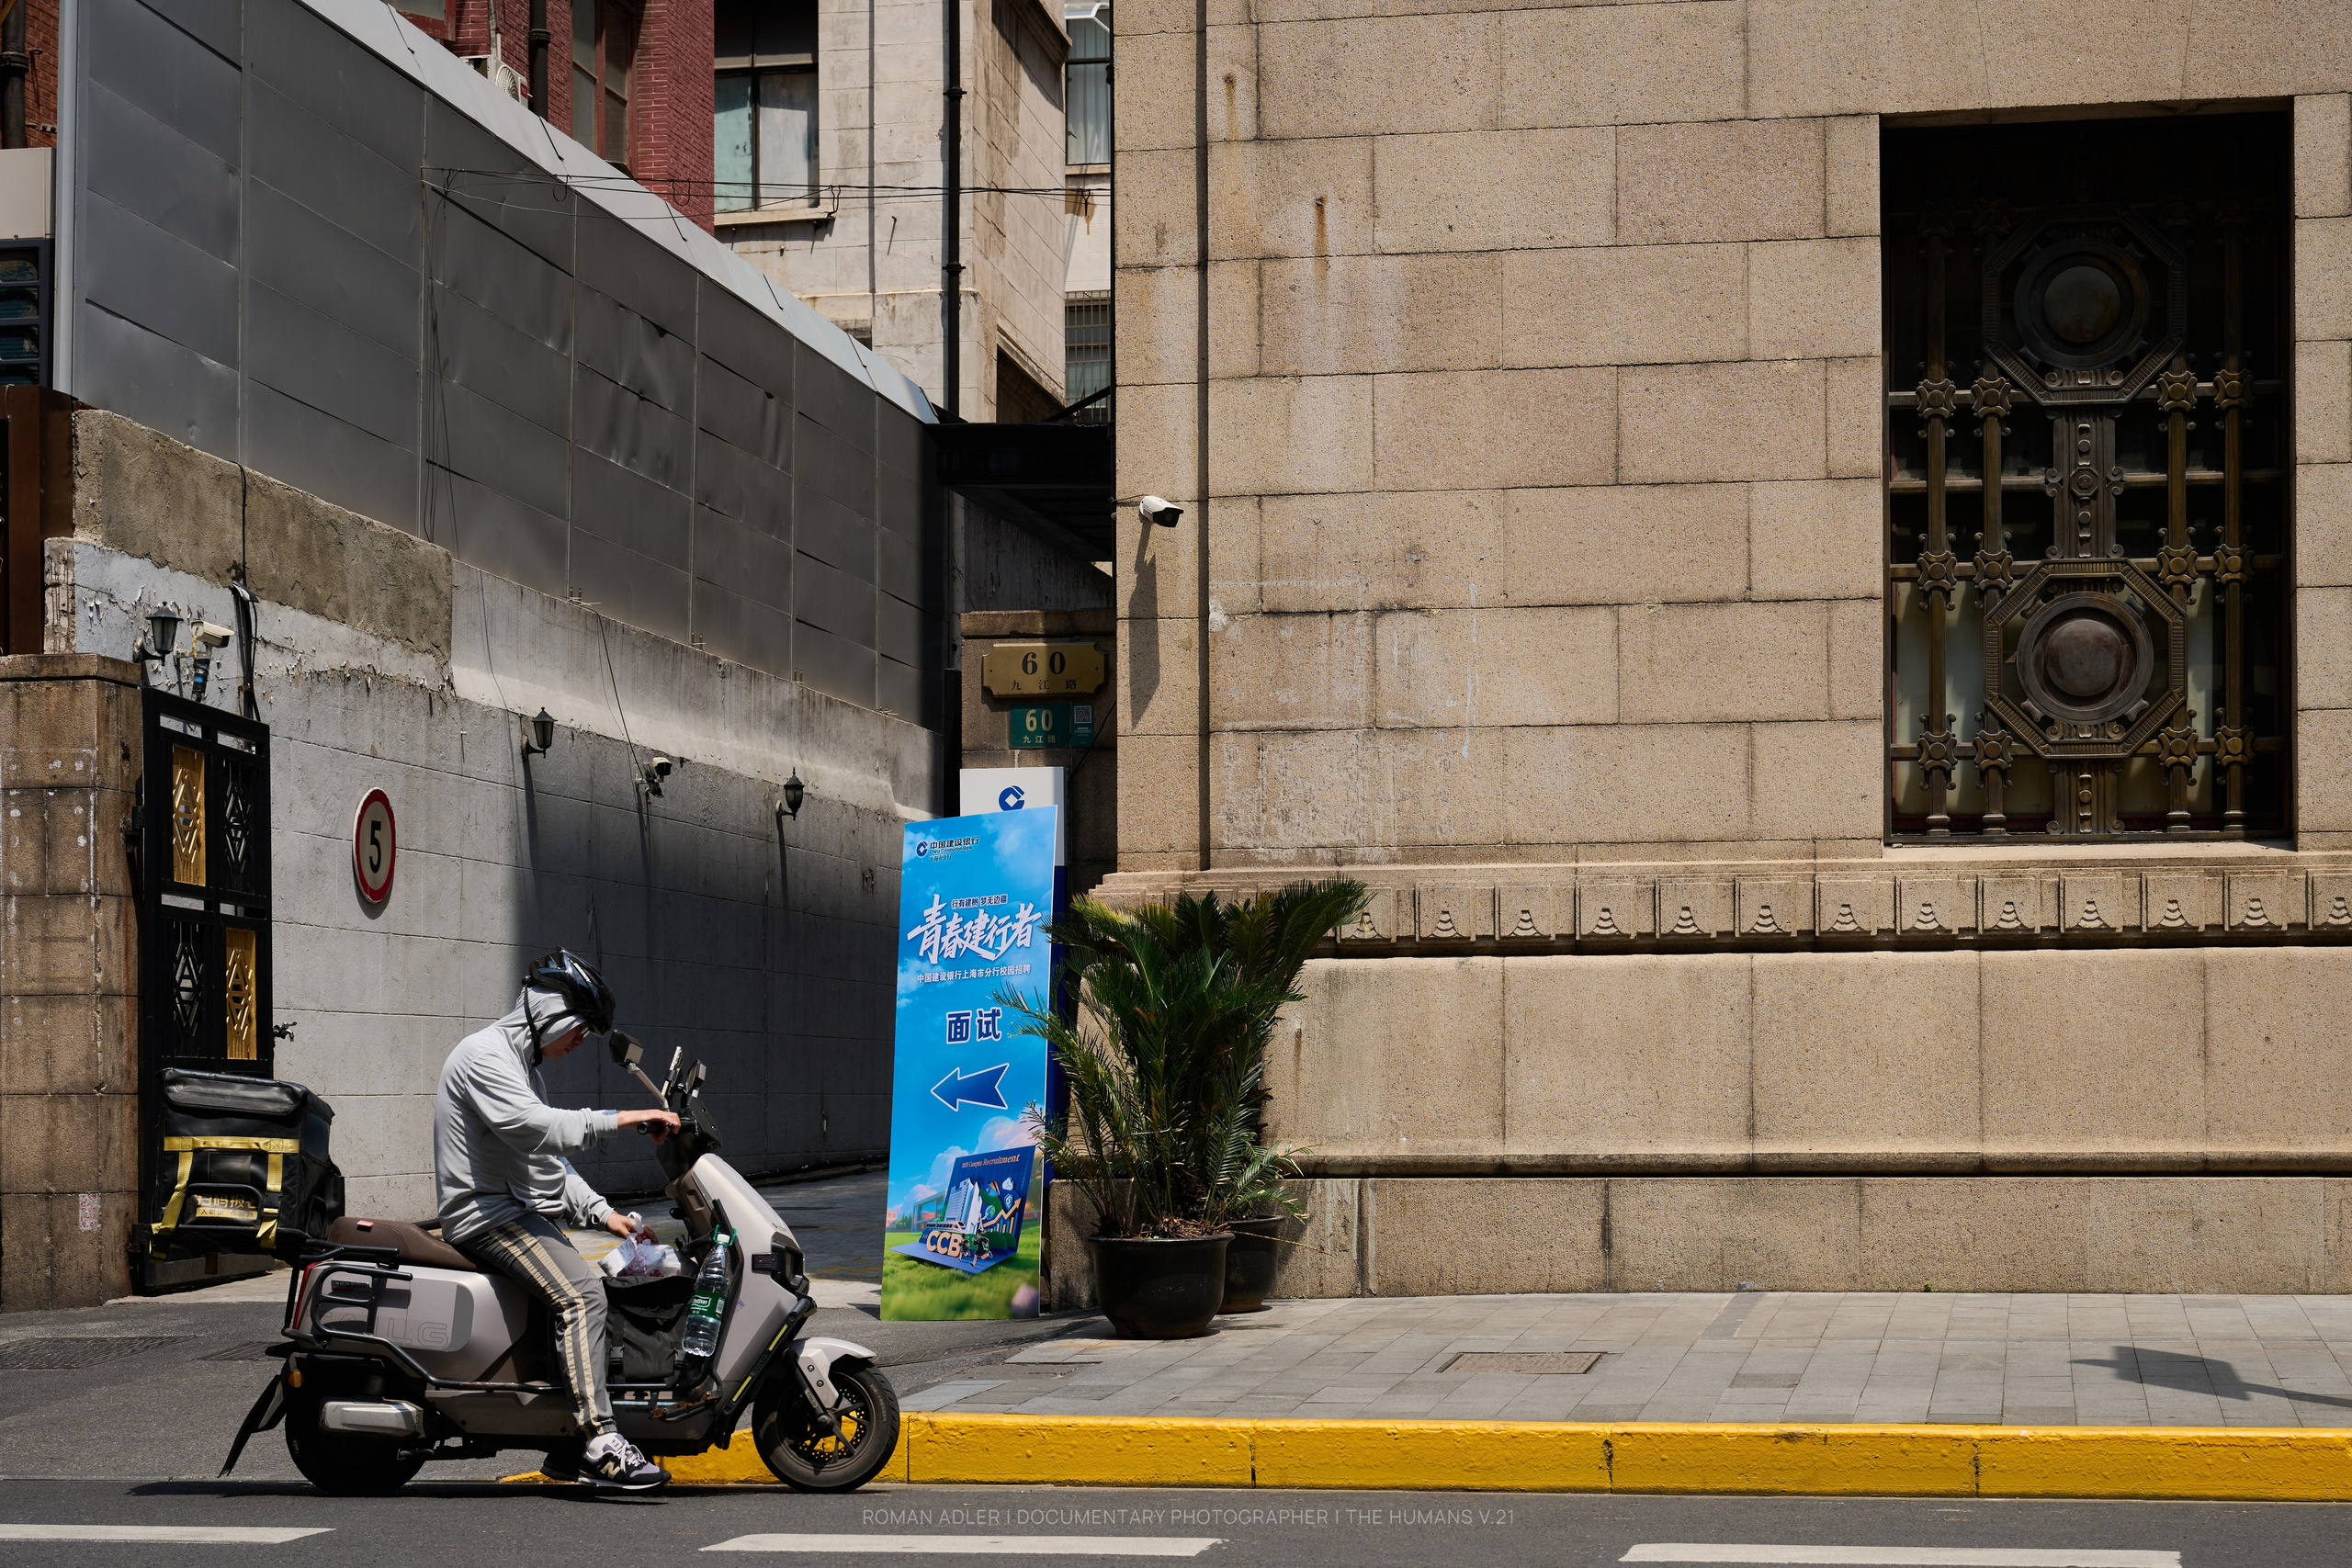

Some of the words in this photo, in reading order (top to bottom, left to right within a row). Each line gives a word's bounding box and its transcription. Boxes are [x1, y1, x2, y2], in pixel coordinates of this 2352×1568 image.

[1022, 651, 1066, 675] 60
[1012, 680, 1077, 691] 九江路
[1025, 709, 1053, 732] 60
[1023, 735, 1056, 744] 九江路
[369, 820, 381, 874] 5
[930, 837, 979, 849] 中国建设银行
[952, 897, 978, 909] 行有建树
[980, 894, 1008, 906] 梦无边疆
[907, 894, 1042, 964] 青春建行者
[917, 964, 1031, 984] 中国建设银行上海市分行校园招聘
[946, 1008, 1002, 1044] 面试
[983, 1154, 1021, 1166] Recruitment
[926, 1230, 962, 1258] CCB
